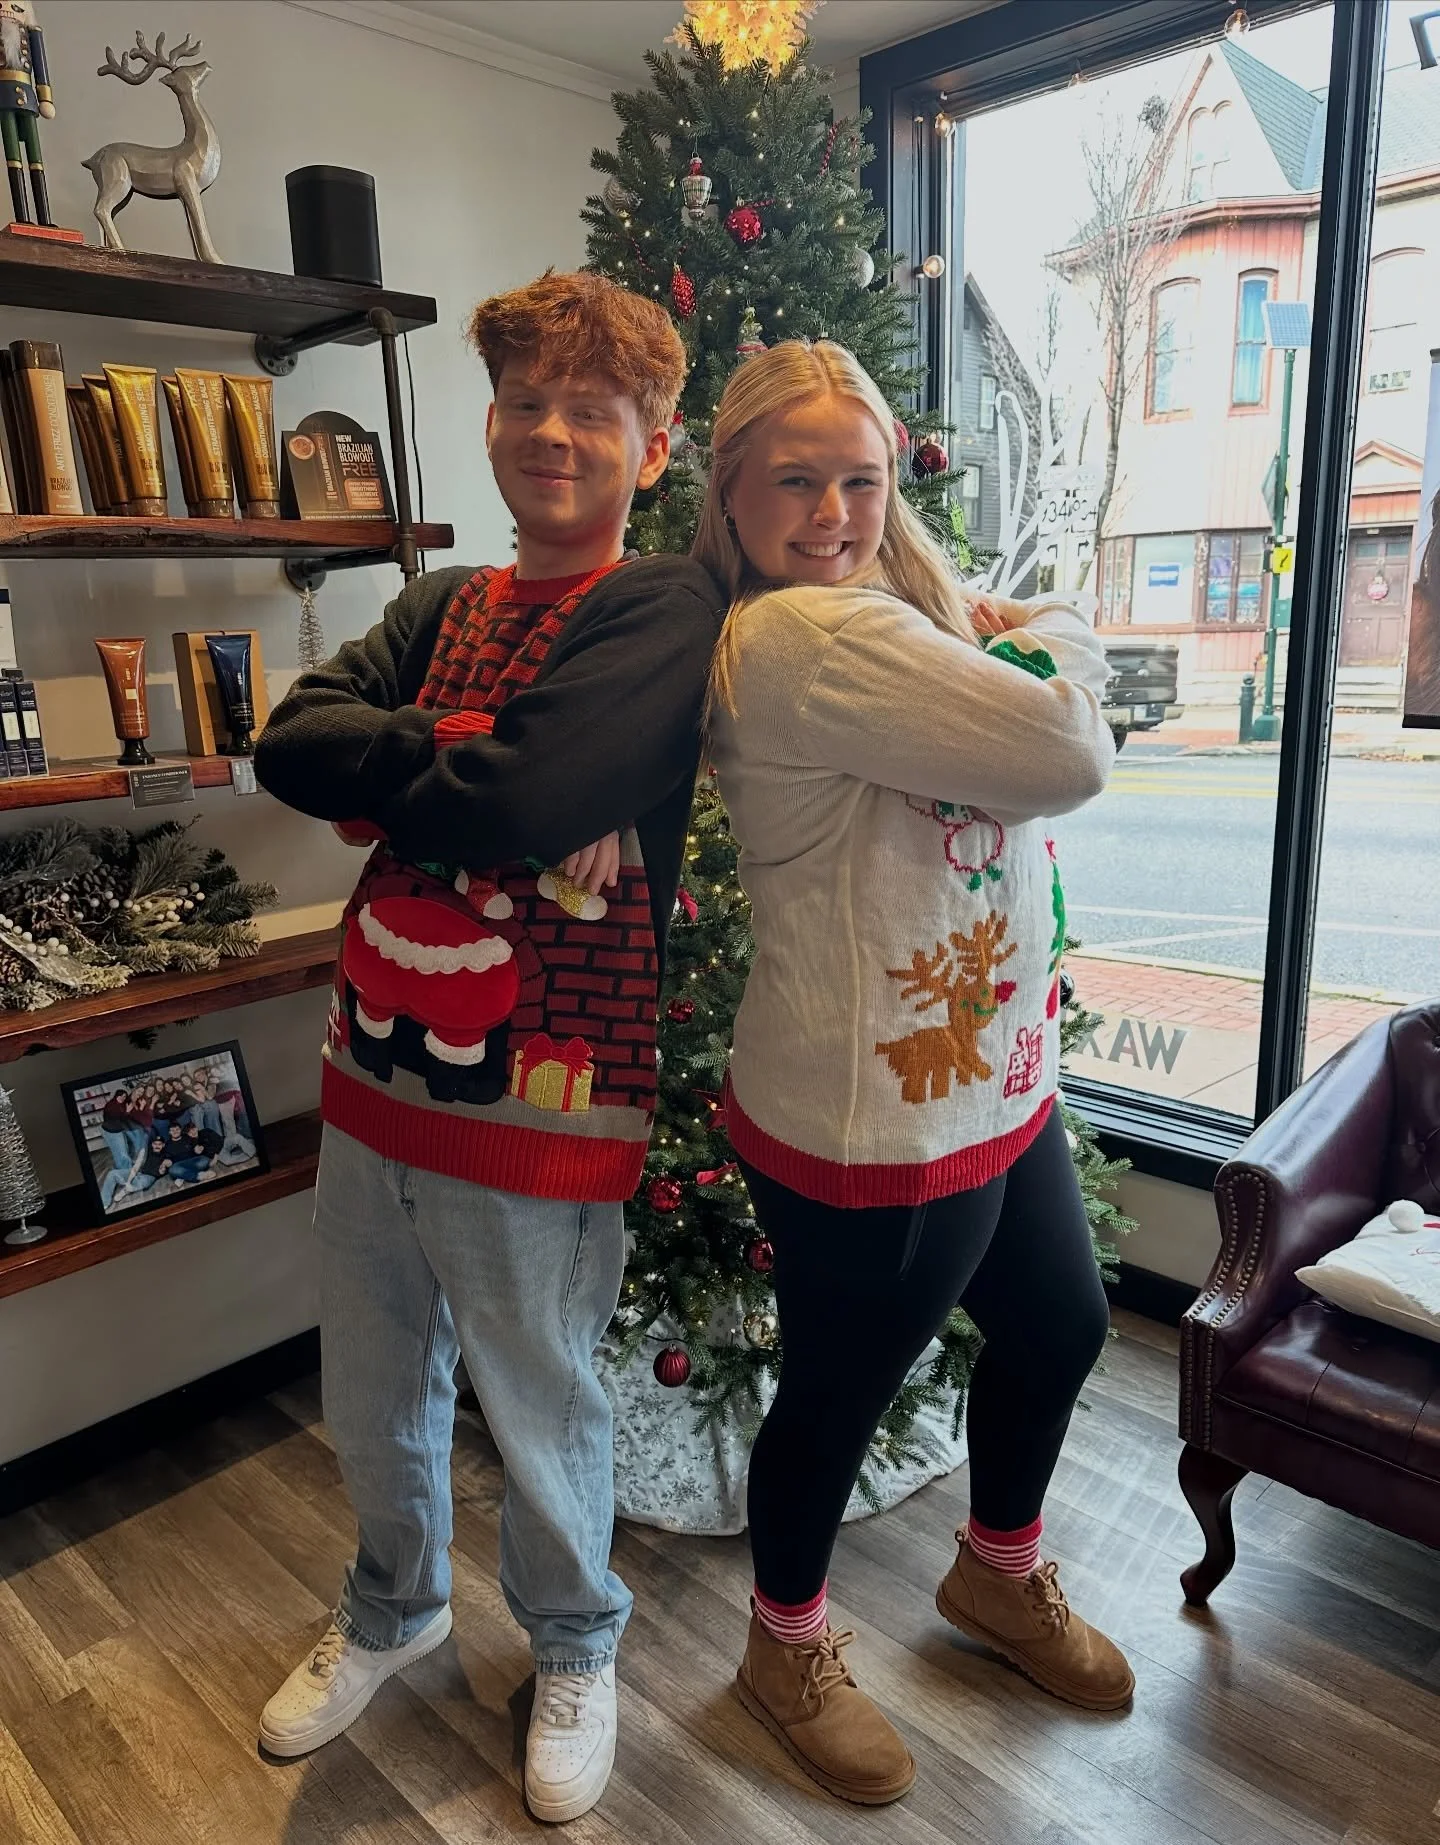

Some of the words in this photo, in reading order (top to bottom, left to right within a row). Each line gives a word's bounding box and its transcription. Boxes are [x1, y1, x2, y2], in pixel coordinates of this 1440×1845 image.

[198, 378, 208, 399] BALM
[210, 379, 222, 410] TAME
[249, 383, 261, 410] MASQUE
[139, 403, 153, 452] SMOOTHING
[203, 400, 220, 457] STRAIGHTENING
[256, 411, 269, 459] CONDITIONING
[335, 434, 352, 443] NEW
[337, 443, 373, 453] BRAZILIAN
[340, 452, 375, 463] BLOWOUT
[342, 462, 379, 477] FREE
